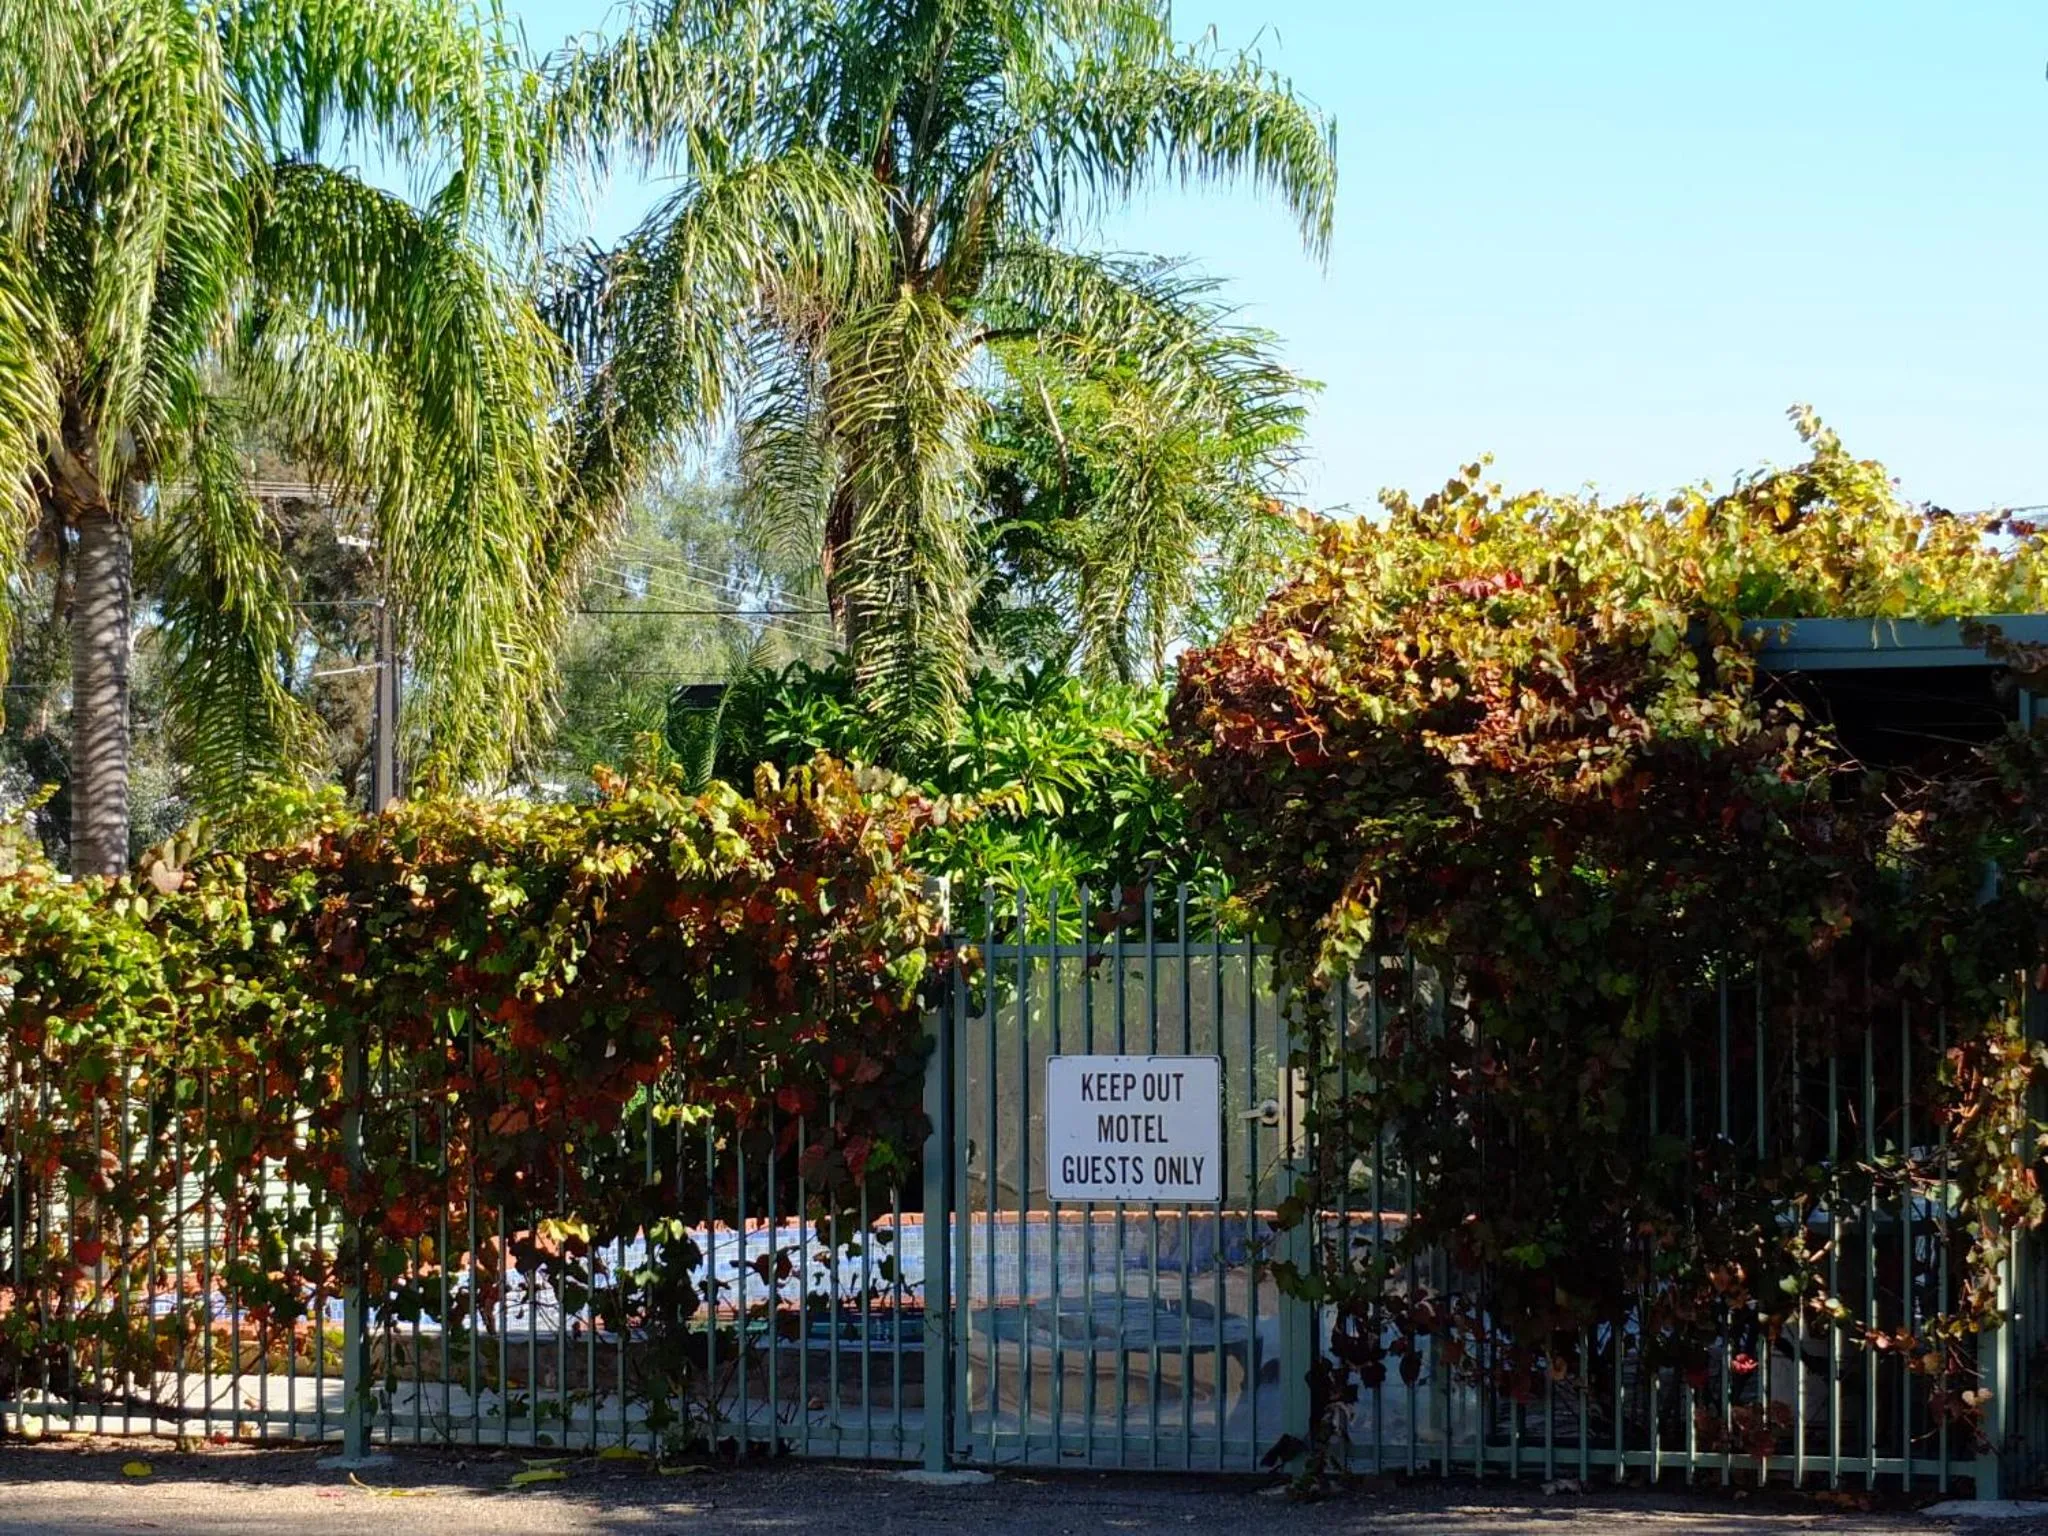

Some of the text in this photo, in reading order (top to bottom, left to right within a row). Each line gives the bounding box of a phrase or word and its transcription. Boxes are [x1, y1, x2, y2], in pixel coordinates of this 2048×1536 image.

[1081, 1072, 1185, 1102] KEEP OUT
[1097, 1114, 1169, 1144] MOTEL
[1062, 1155, 1205, 1186] GUESTS ONLY
